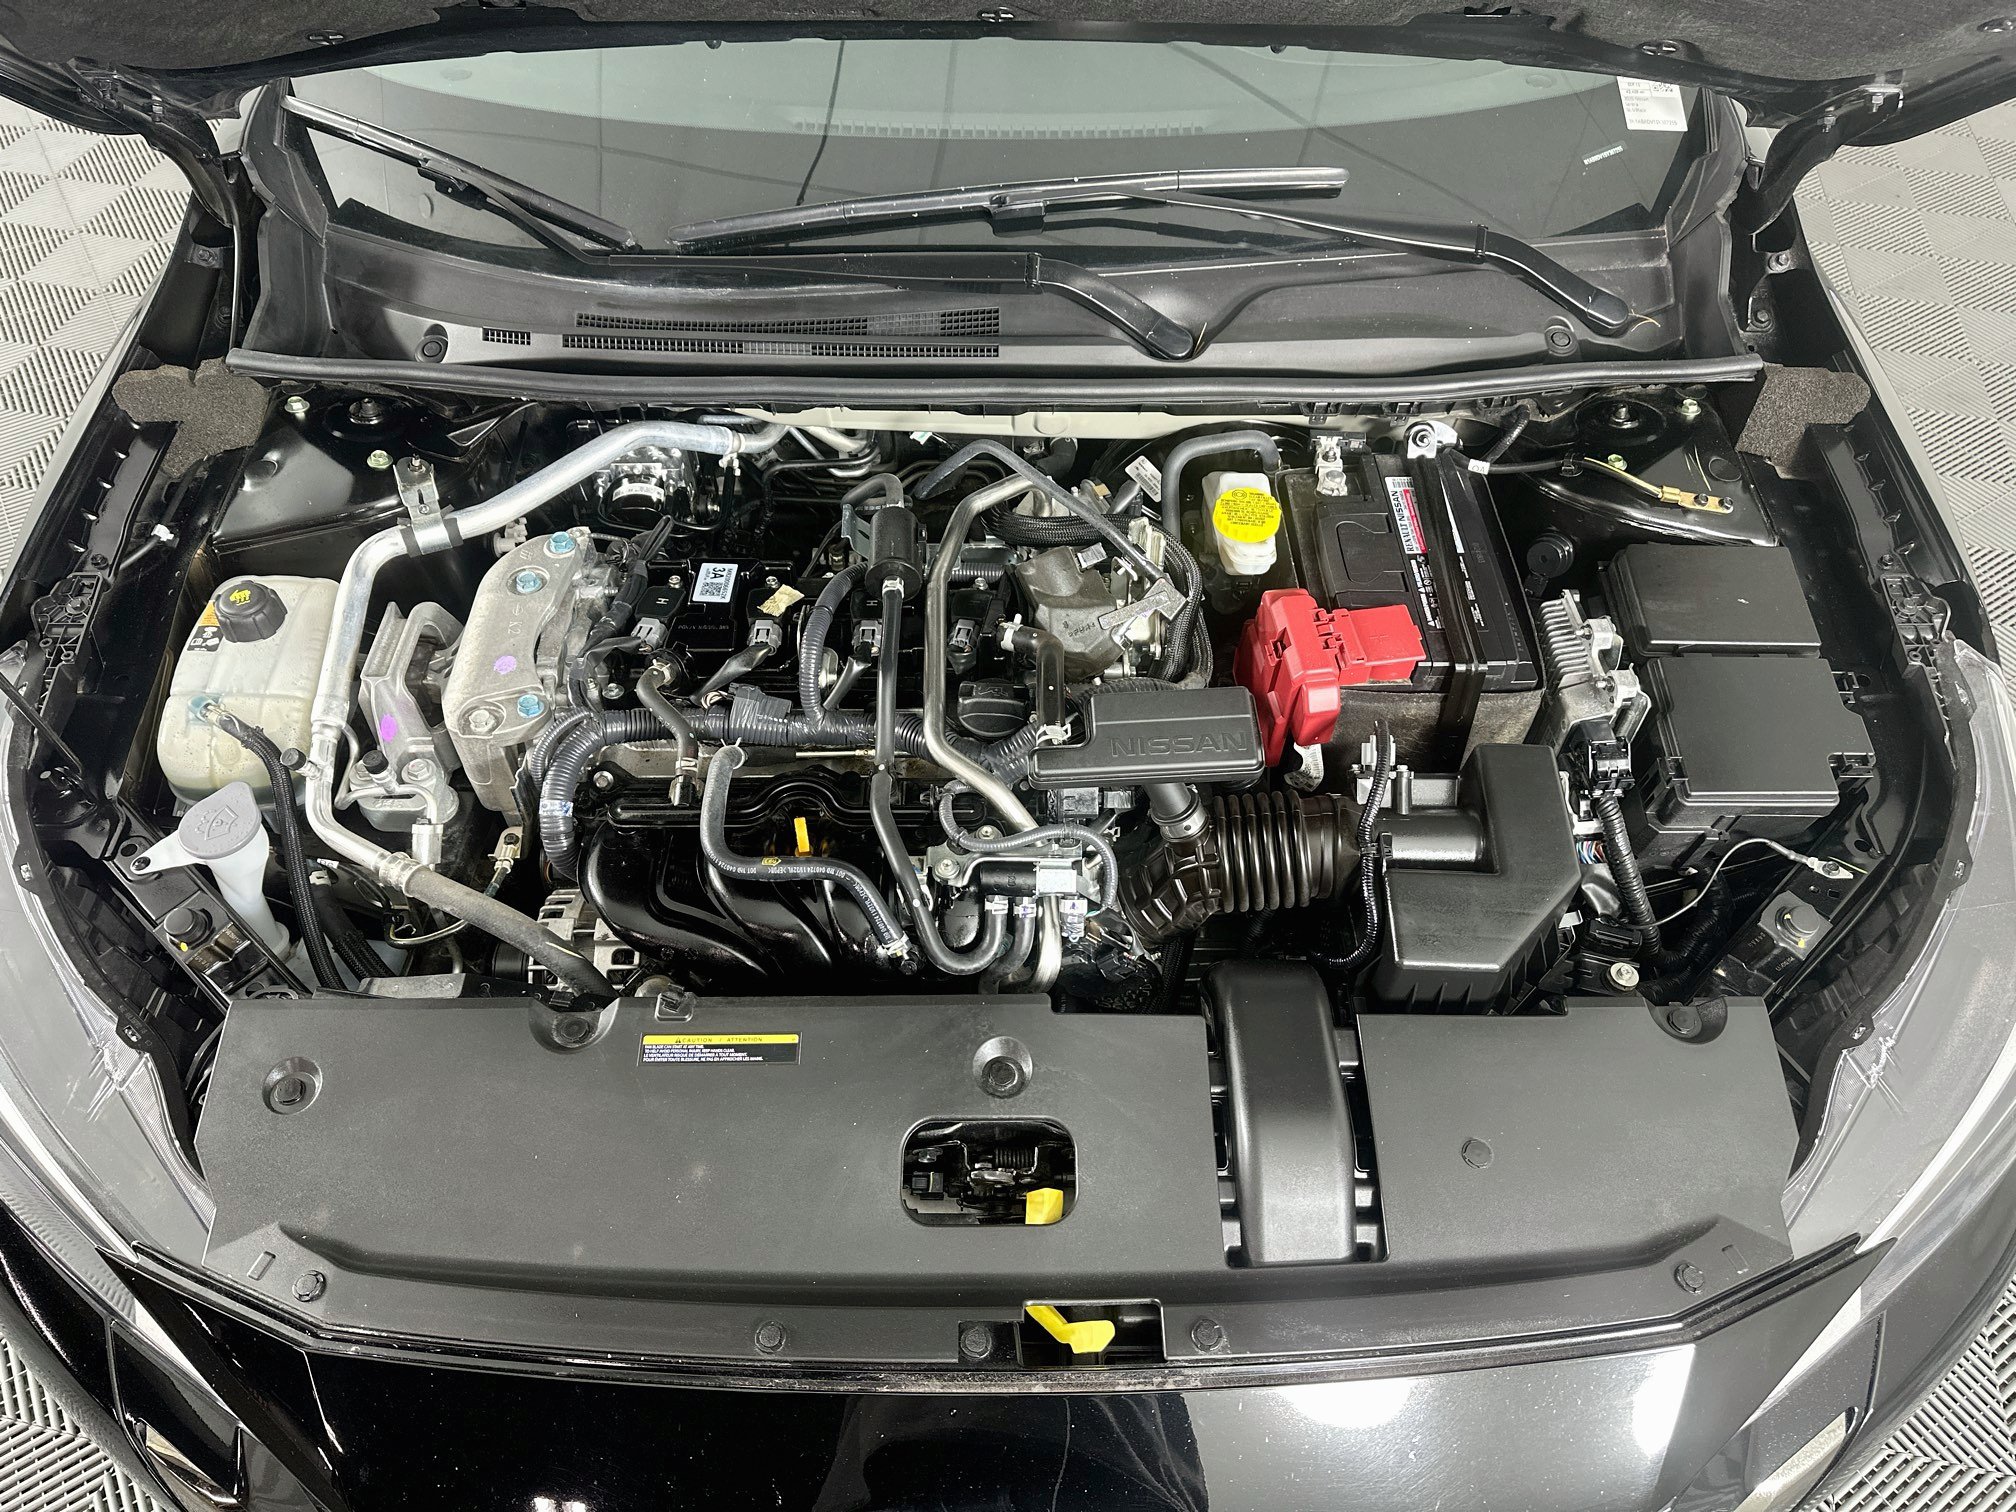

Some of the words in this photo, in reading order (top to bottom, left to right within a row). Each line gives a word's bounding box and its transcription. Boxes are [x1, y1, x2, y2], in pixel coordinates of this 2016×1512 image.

[1391, 490, 1406, 522] NISSAN
[1400, 523, 1415, 552] RENAULT
[710, 567, 726, 579] 3A
[1110, 732, 1248, 758] NISSAN
